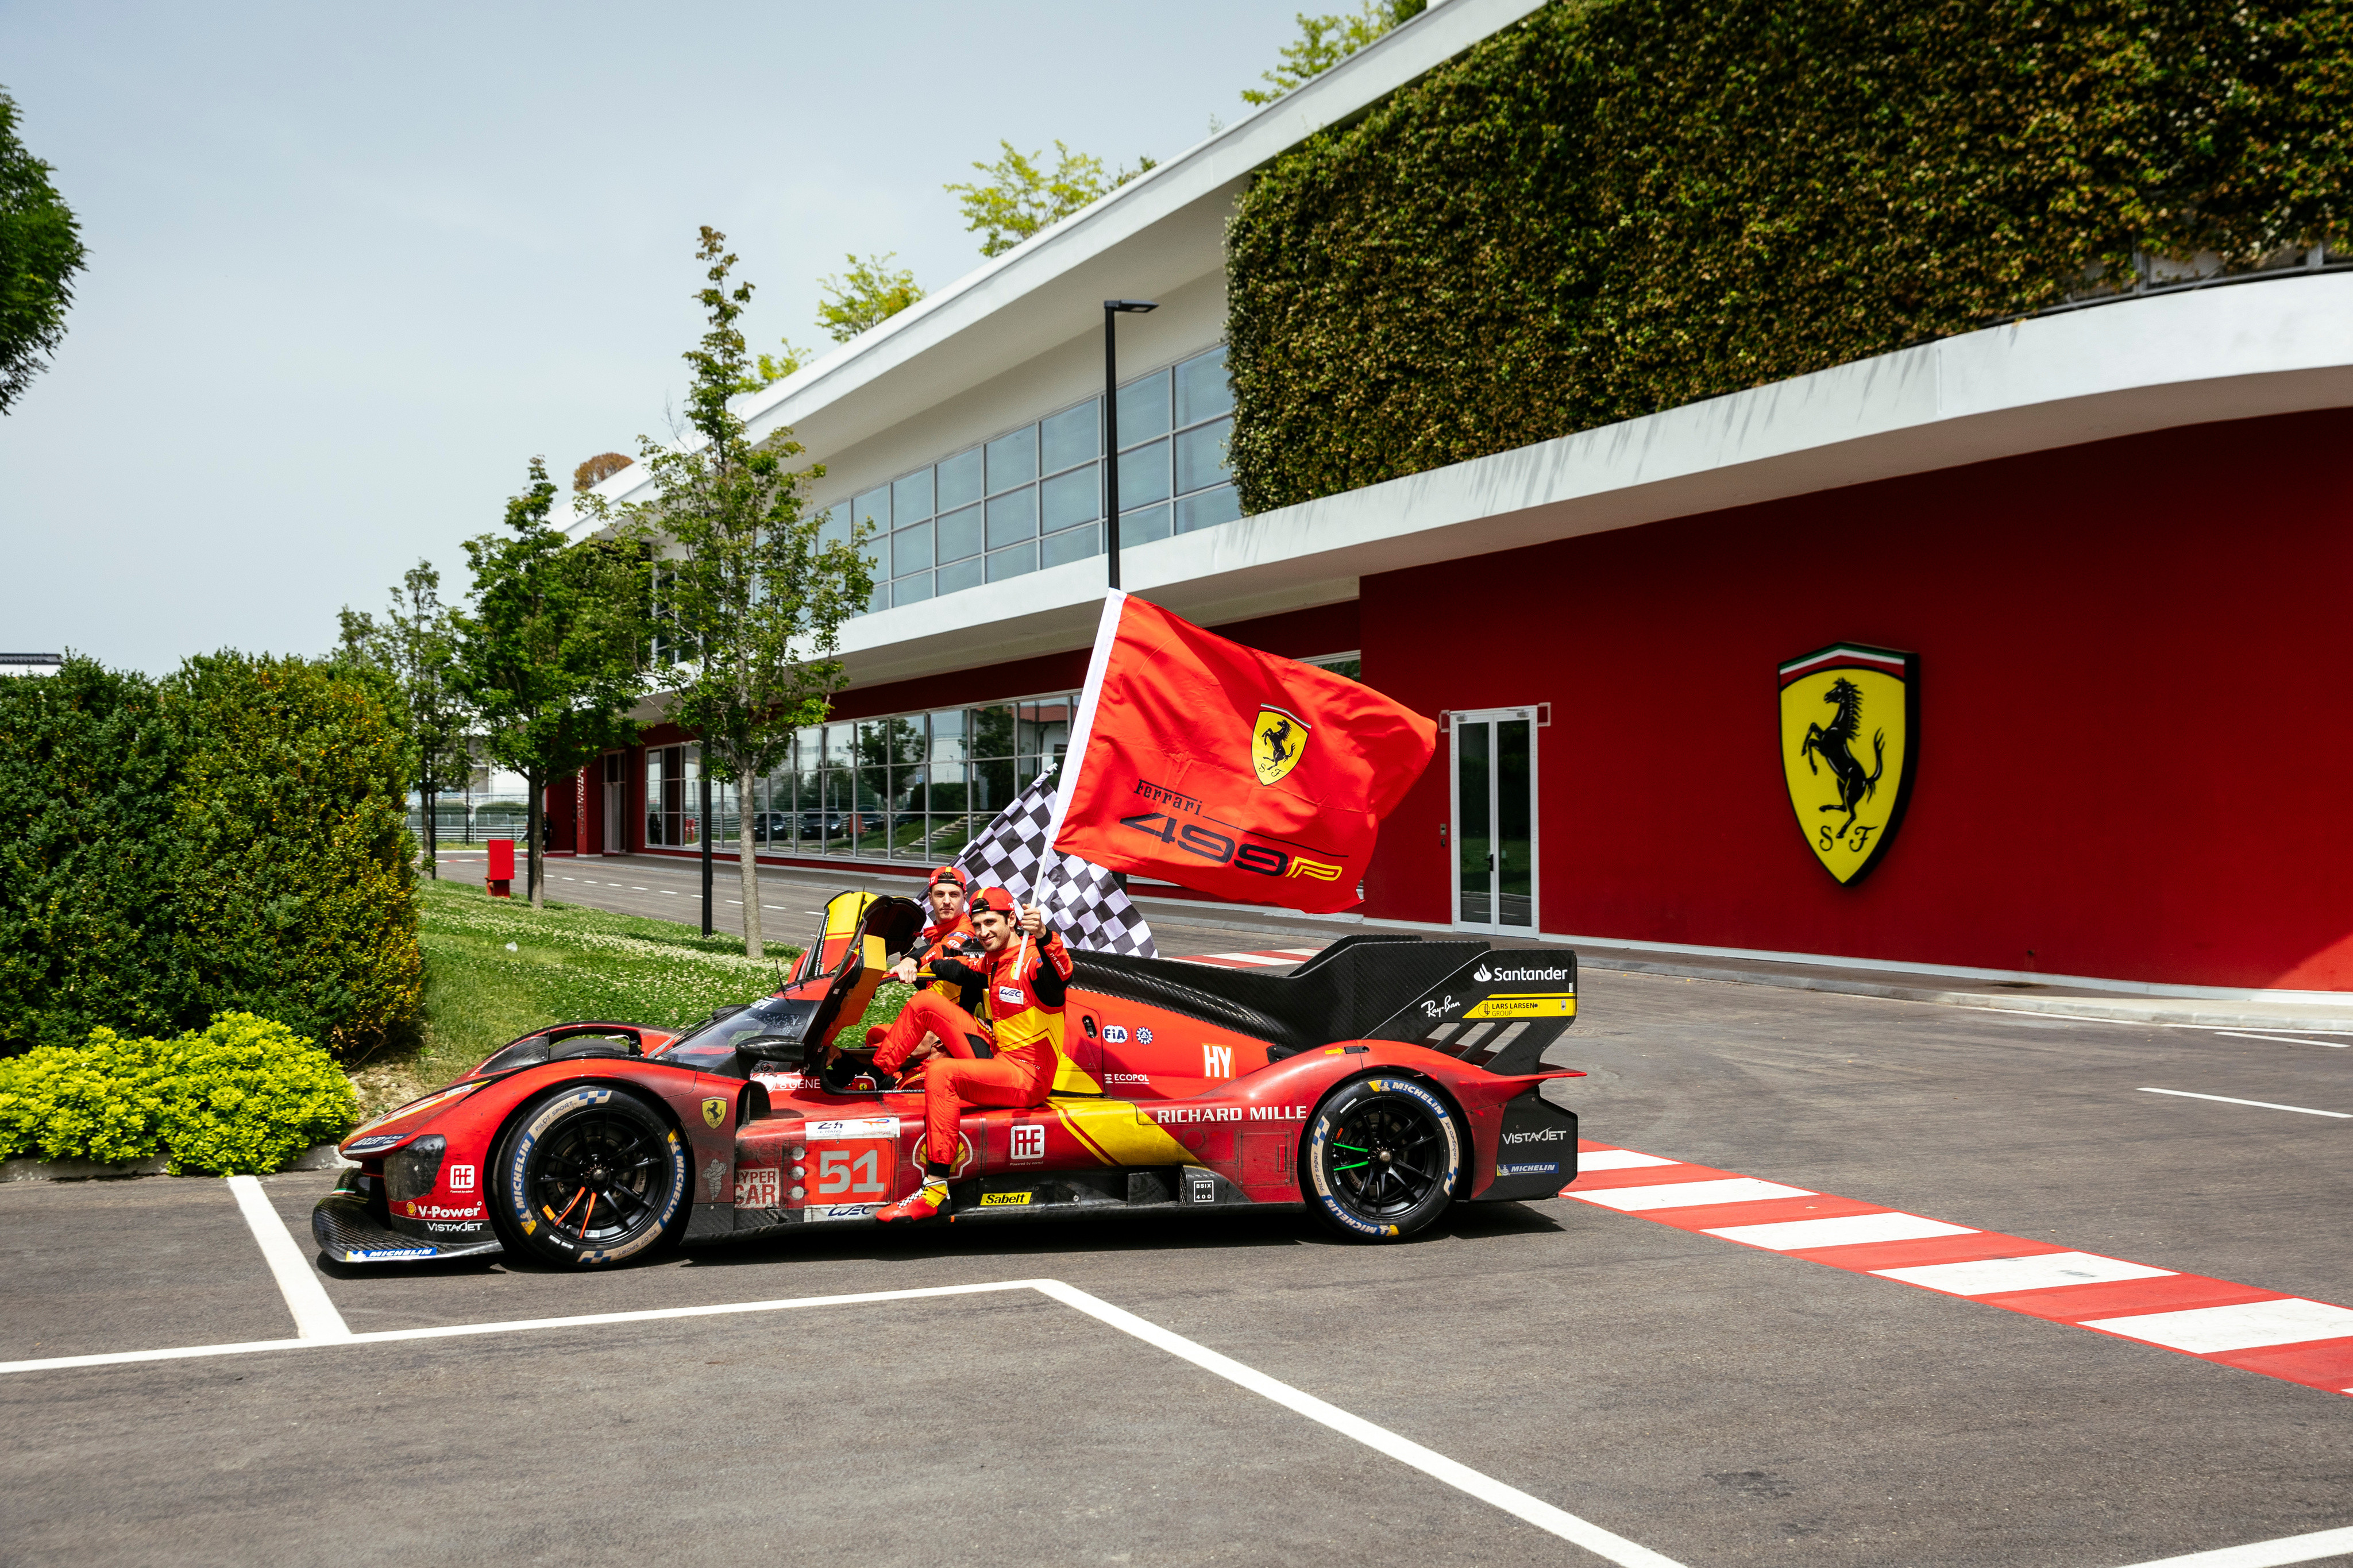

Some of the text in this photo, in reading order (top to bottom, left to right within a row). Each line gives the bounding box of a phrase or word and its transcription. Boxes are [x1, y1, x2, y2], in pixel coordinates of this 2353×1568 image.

[1259, 763, 1266, 773] S
[1134, 779, 1203, 816] Ferrari
[1120, 812, 1343, 882] 499P
[1819, 825, 1833, 851] S
[1494, 967, 1568, 981] Santander
[1203, 1045, 1232, 1078] HY
[1392, 1082, 1444, 1115] MICHELIN
[535, 1100, 573, 1131] PILOT SPORT
[1158, 1106, 1307, 1123] RICHARD MILLE
[513, 1138, 532, 1209] MICHELIN
[819, 1149, 885, 1194] 51
[1511, 1164, 1555, 1172] MICHELIN
[662, 1155, 685, 1223] MICHELIN
[735, 1184, 776, 1205] CAR
[1316, 1173, 1325, 1191] PILOT
[418, 1205, 480, 1218] V-Power
[828, 1205, 873, 1216] WEC
[986, 1194, 1026, 1204] Sabelt
[1325, 1199, 1378, 1234] MICHELIN
[369, 1249, 432, 1258] MICHELIN
[618, 1230, 657, 1256] PILOT SPORT
